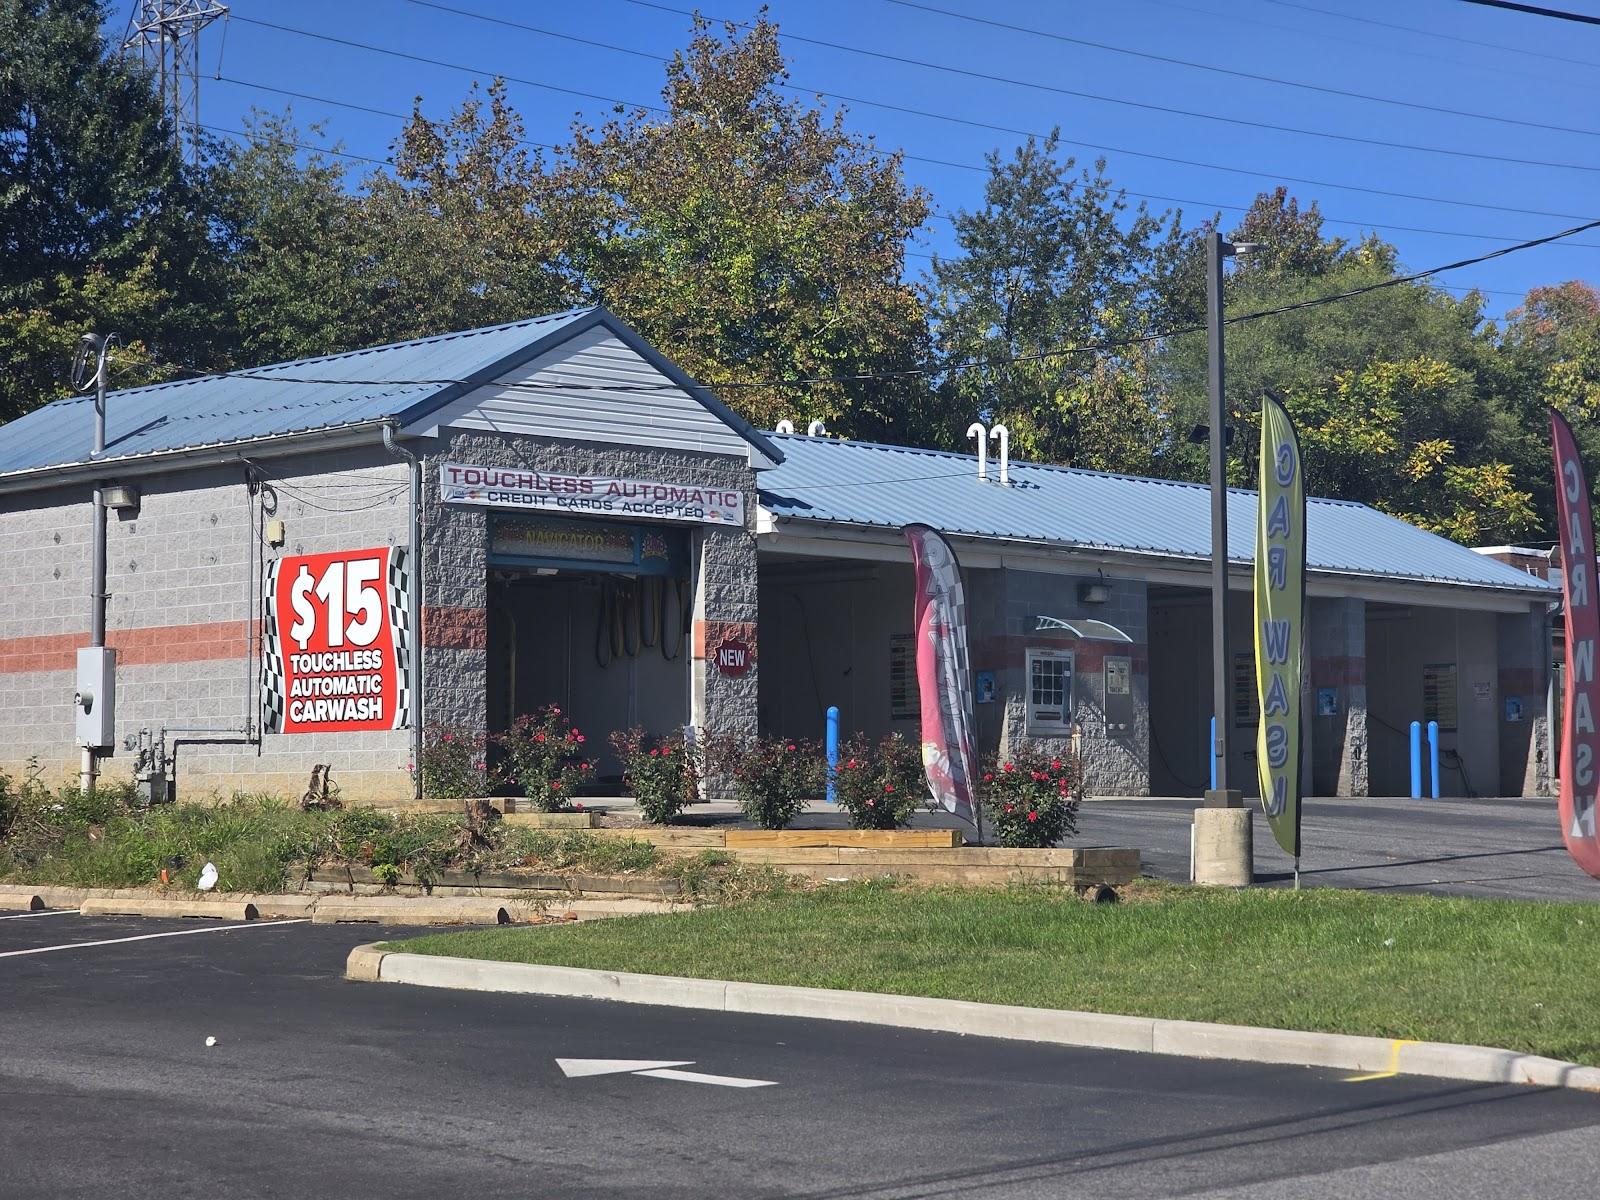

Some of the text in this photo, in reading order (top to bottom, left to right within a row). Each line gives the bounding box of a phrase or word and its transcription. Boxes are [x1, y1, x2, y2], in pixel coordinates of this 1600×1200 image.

[447, 468, 738, 508] TOUCHLESS AUTOMATIC
[487, 491, 704, 519] CREDIT CARDS ACCEPTED
[526, 530, 604, 552] NAVIGATOR
[289, 558, 383, 651] $15
[289, 649, 383, 674] TOUCHLESS
[720, 649, 745, 667] NEW
[289, 673, 383, 698] AUTOMATIC
[289, 698, 383, 723] CARWASH
